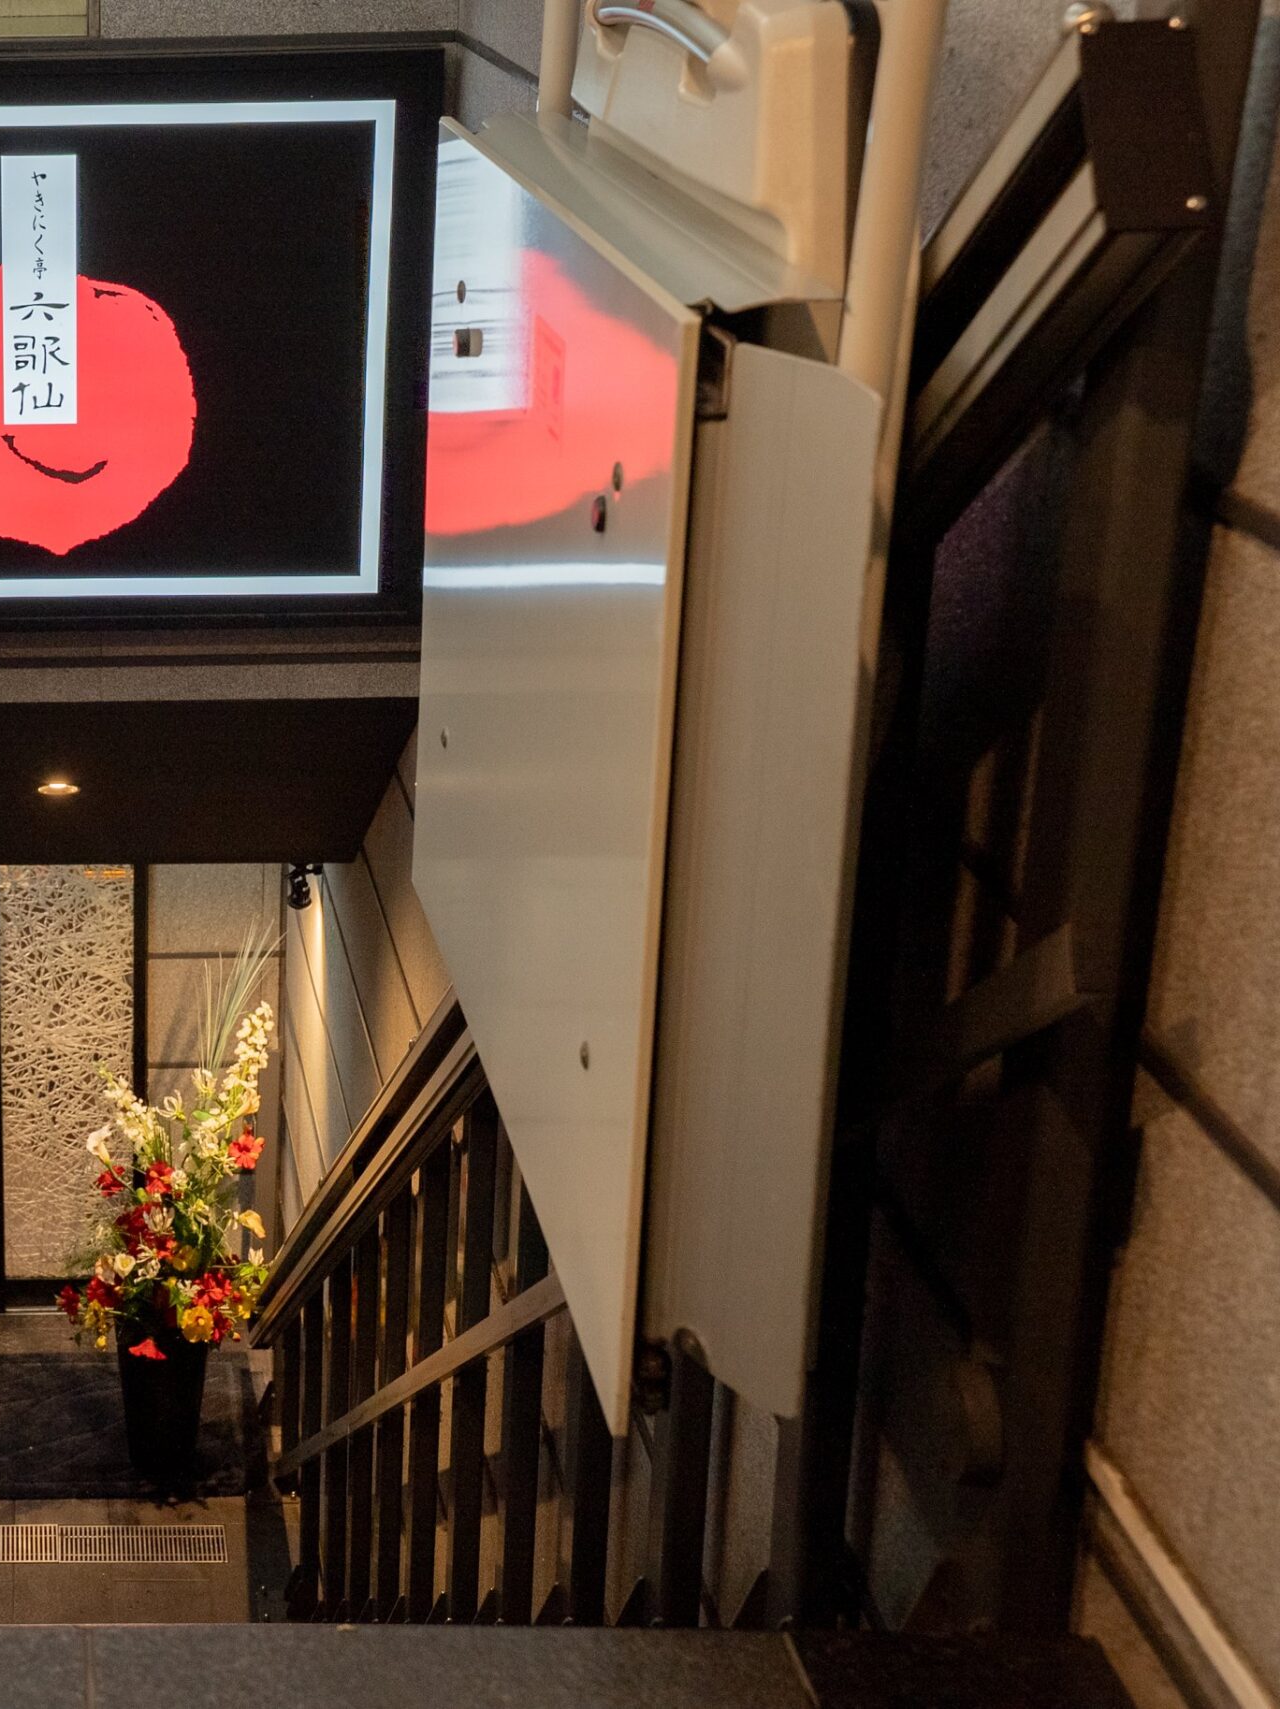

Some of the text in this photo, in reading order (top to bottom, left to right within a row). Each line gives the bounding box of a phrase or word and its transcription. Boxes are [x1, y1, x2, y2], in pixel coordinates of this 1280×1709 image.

[30, 170, 48, 281] やきにく亭
[8, 291, 71, 416] 六歌仙
